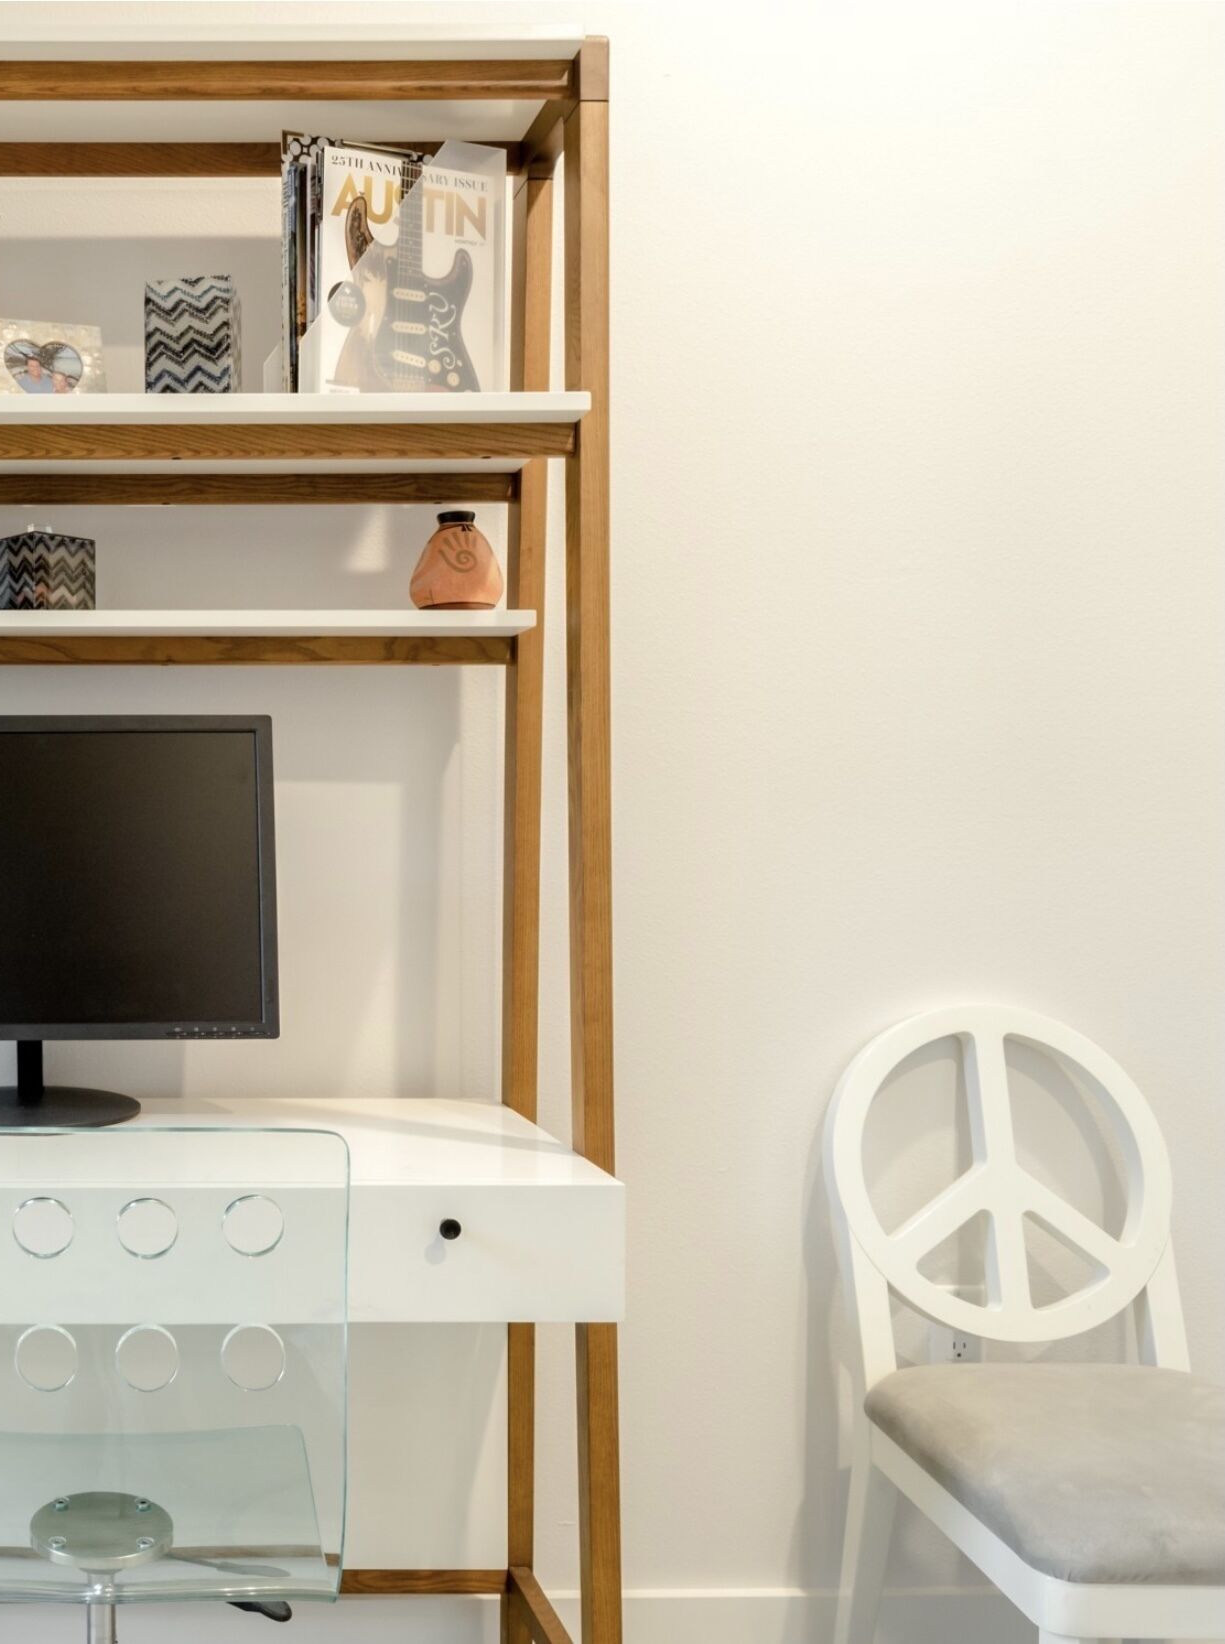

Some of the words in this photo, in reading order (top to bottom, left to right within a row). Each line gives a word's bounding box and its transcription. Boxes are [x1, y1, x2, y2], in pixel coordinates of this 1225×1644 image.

[331, 155, 364, 169] 25TH
[368, 159, 452, 184] ANNIVARY
[454, 176, 489, 192] ISSUE
[331, 173, 487, 241] AUTIN
